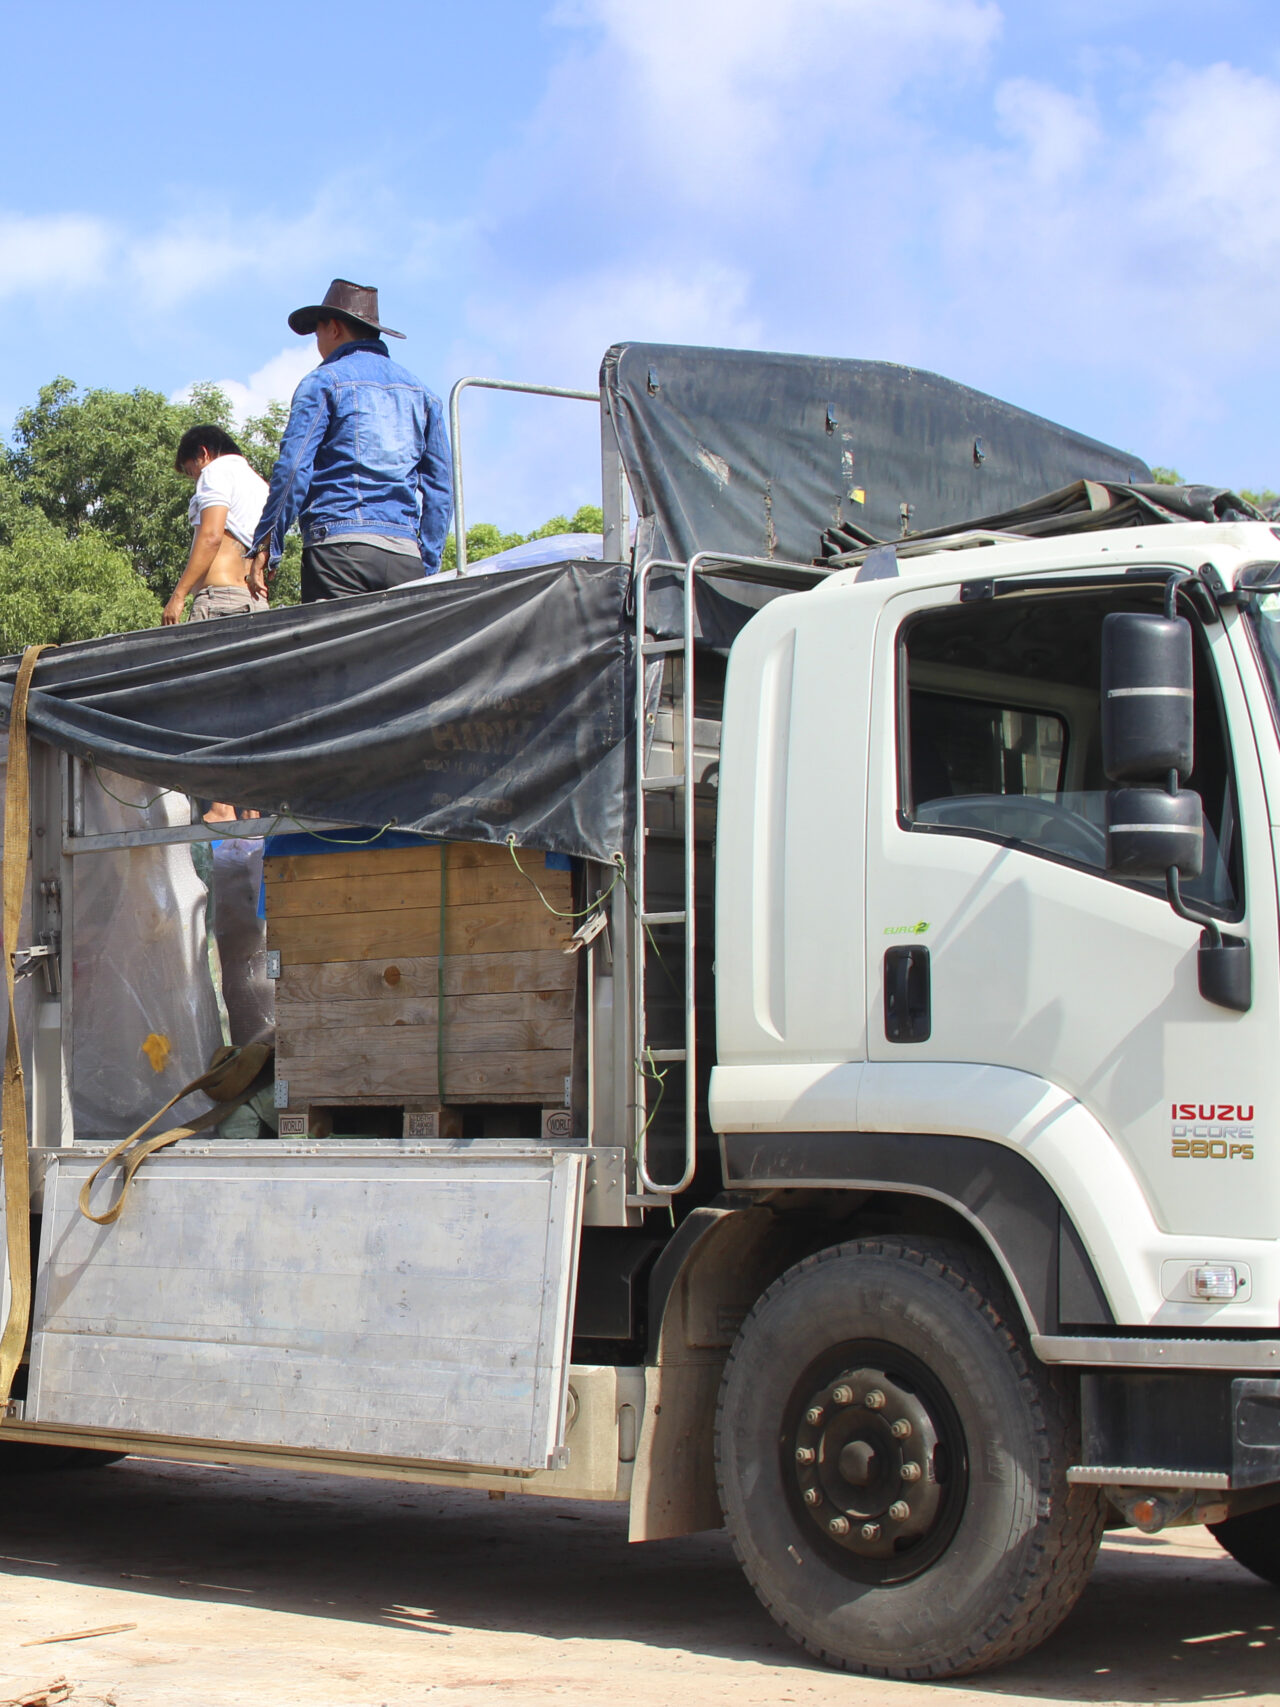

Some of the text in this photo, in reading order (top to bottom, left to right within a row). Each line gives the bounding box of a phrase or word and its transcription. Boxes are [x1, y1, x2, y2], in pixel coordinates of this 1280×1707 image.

[1171, 1103, 1254, 1121] ISUZU
[282, 1120, 303, 1132] WORLD
[1171, 1124, 1254, 1139] D-CORE
[1171, 1139, 1254, 1159] 280PS
